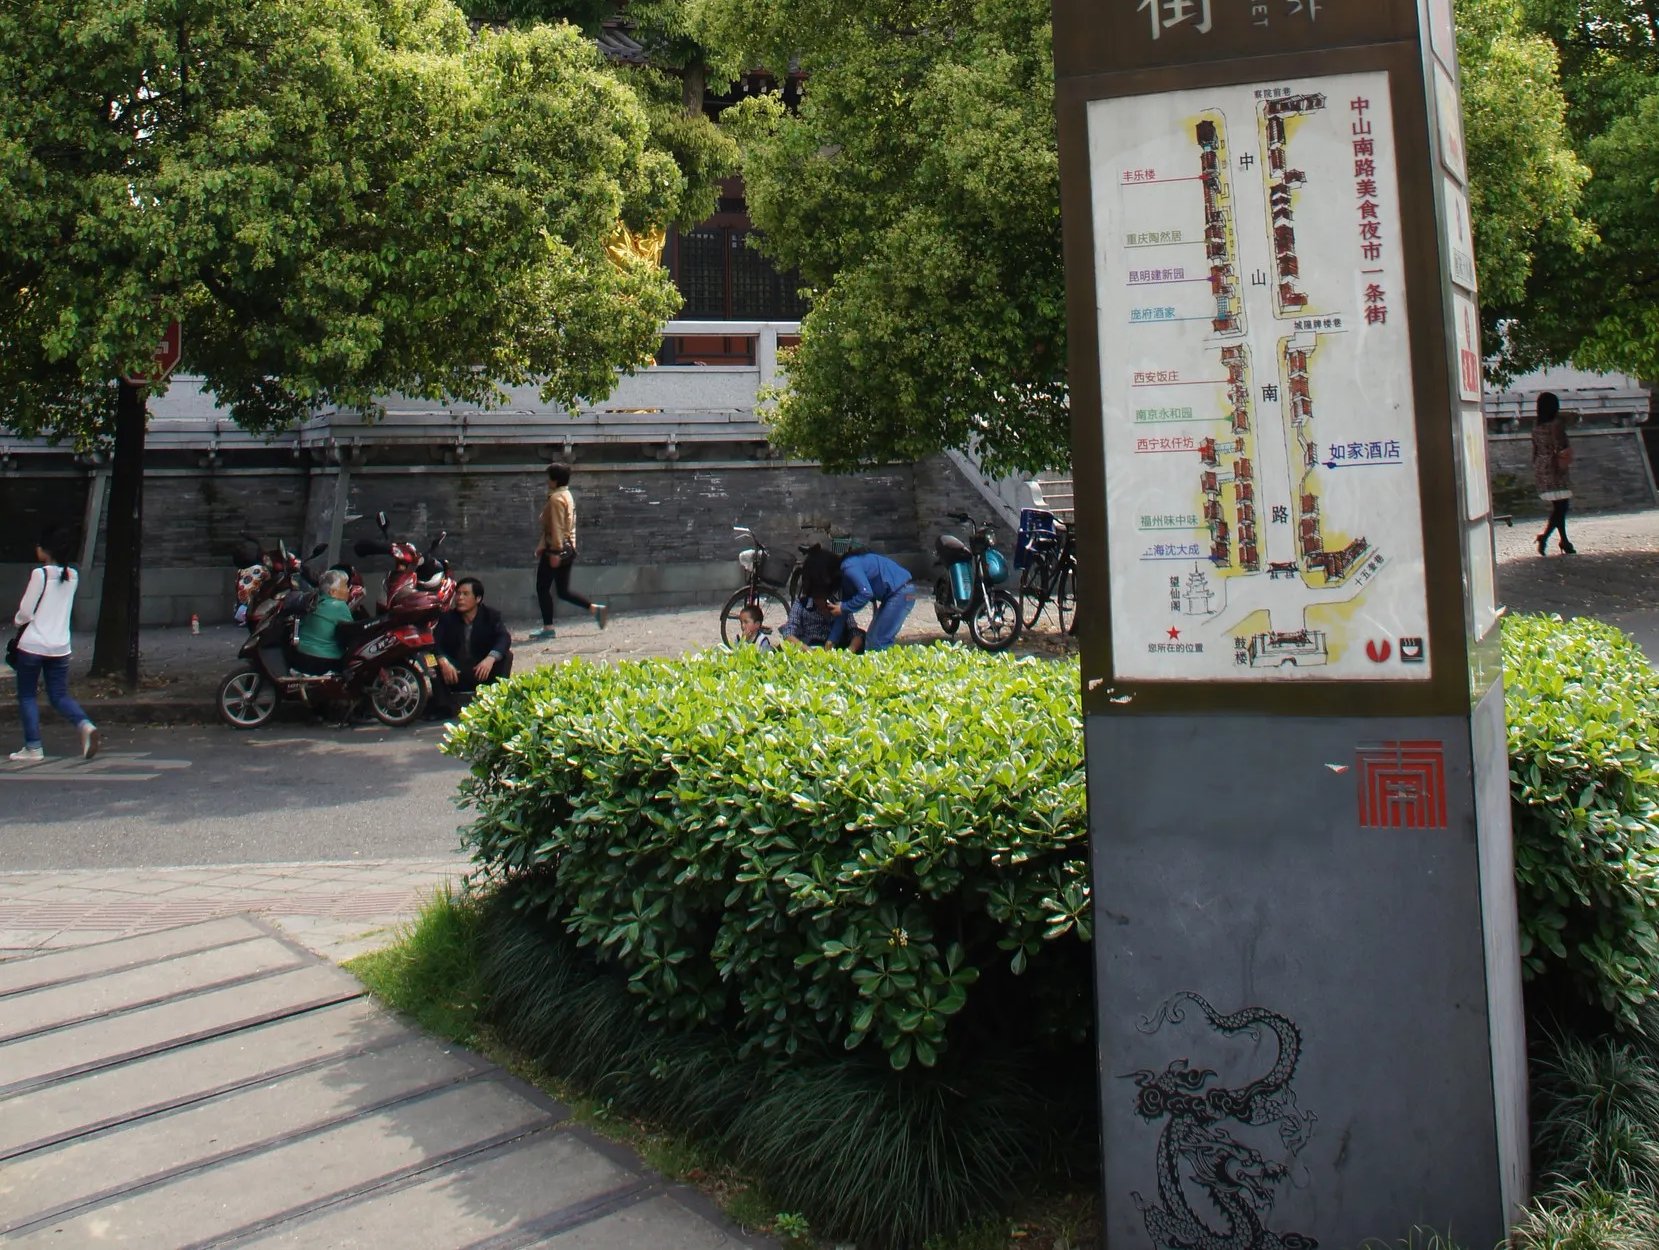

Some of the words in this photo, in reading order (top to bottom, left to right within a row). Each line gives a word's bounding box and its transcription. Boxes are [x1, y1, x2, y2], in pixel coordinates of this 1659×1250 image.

[1122, 168, 1156, 182] 丰乐楼
[1349, 96, 1388, 326] 中山南路美食夜市一条街
[1126, 230, 1182, 245] 重庆陶然居
[1129, 268, 1185, 282] 昆明建新园
[1133, 370, 1179, 384] 西安饭庄
[1136, 407, 1192, 421] 南京永和园
[1137, 437, 1194, 450] 西宁玖仟坊
[1329, 440, 1401, 461] 如家酒店
[1141, 514, 1198, 526] 福州味中味
[1169, 575, 1181, 611] 望仙阁
[1148, 643, 1203, 653] 您所在的位置
[1234, 636, 1247, 665] 鼓楼
